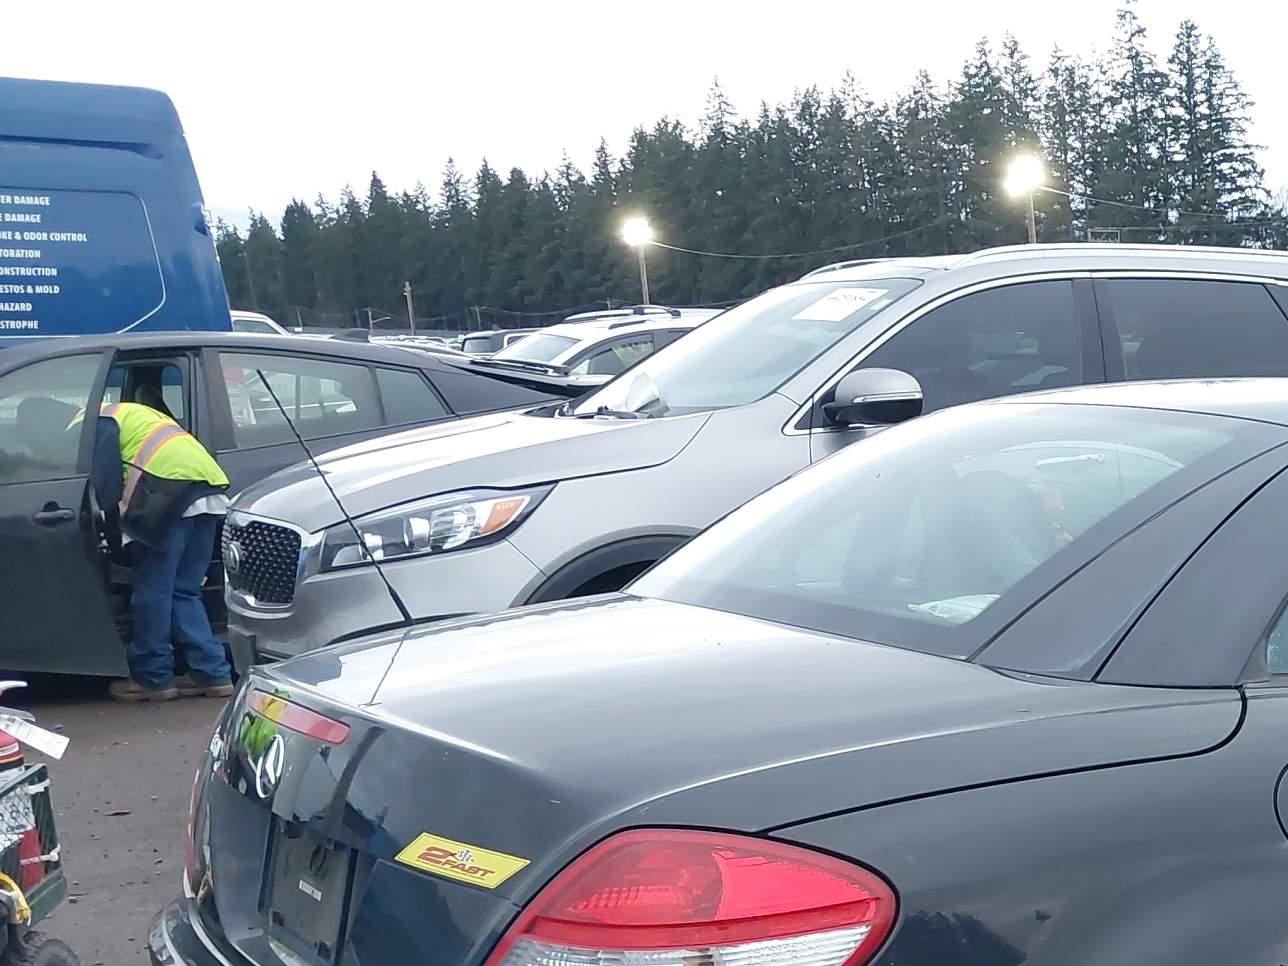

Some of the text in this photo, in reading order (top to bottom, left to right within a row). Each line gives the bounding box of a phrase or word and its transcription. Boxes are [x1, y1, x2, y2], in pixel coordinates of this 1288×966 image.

[14, 196, 51, 206] DAMAGE
[4, 213, 42, 223] DAMAGE
[14, 232, 22, 241] &
[23, 232, 48, 241] ODOR
[49, 233, 88, 242] CONTROL
[0, 285, 60, 294] ESTOS & MOLD
[0, 320, 39, 329] STROPHE
